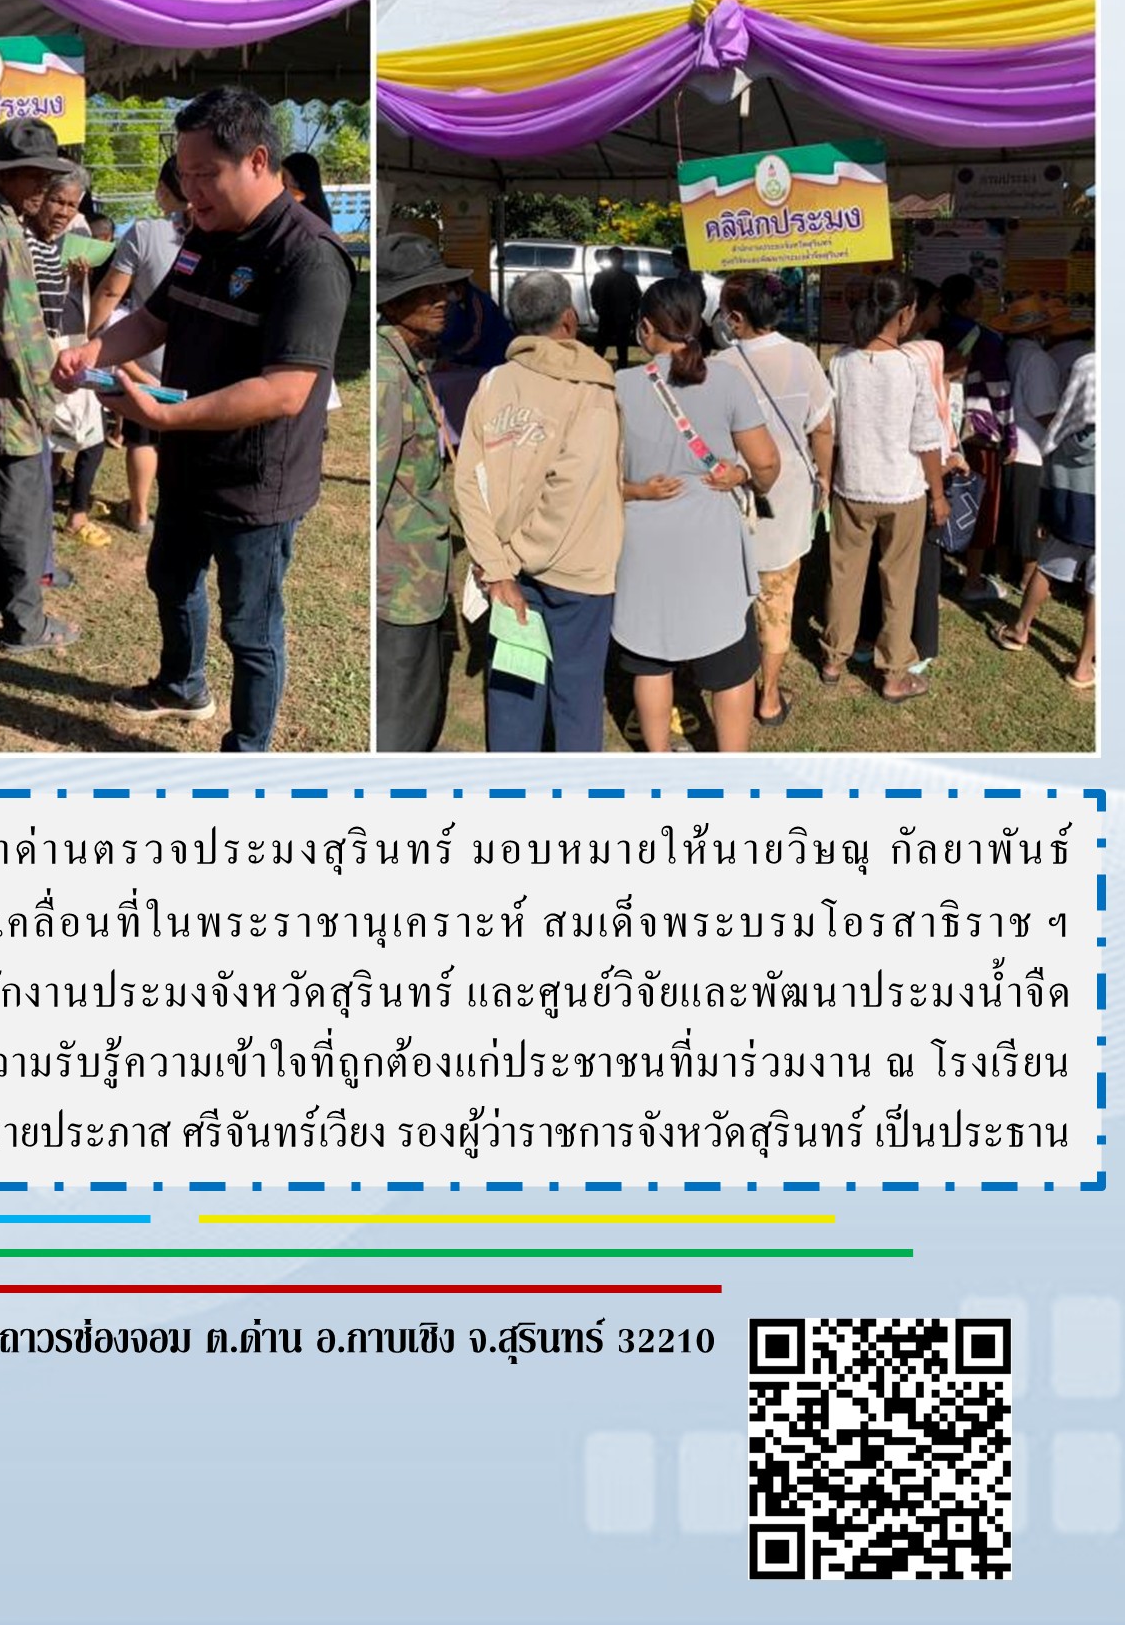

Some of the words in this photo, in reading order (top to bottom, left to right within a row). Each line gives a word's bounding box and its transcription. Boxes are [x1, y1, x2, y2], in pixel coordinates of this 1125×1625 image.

[704, 206, 864, 241] คลินิกประมง
